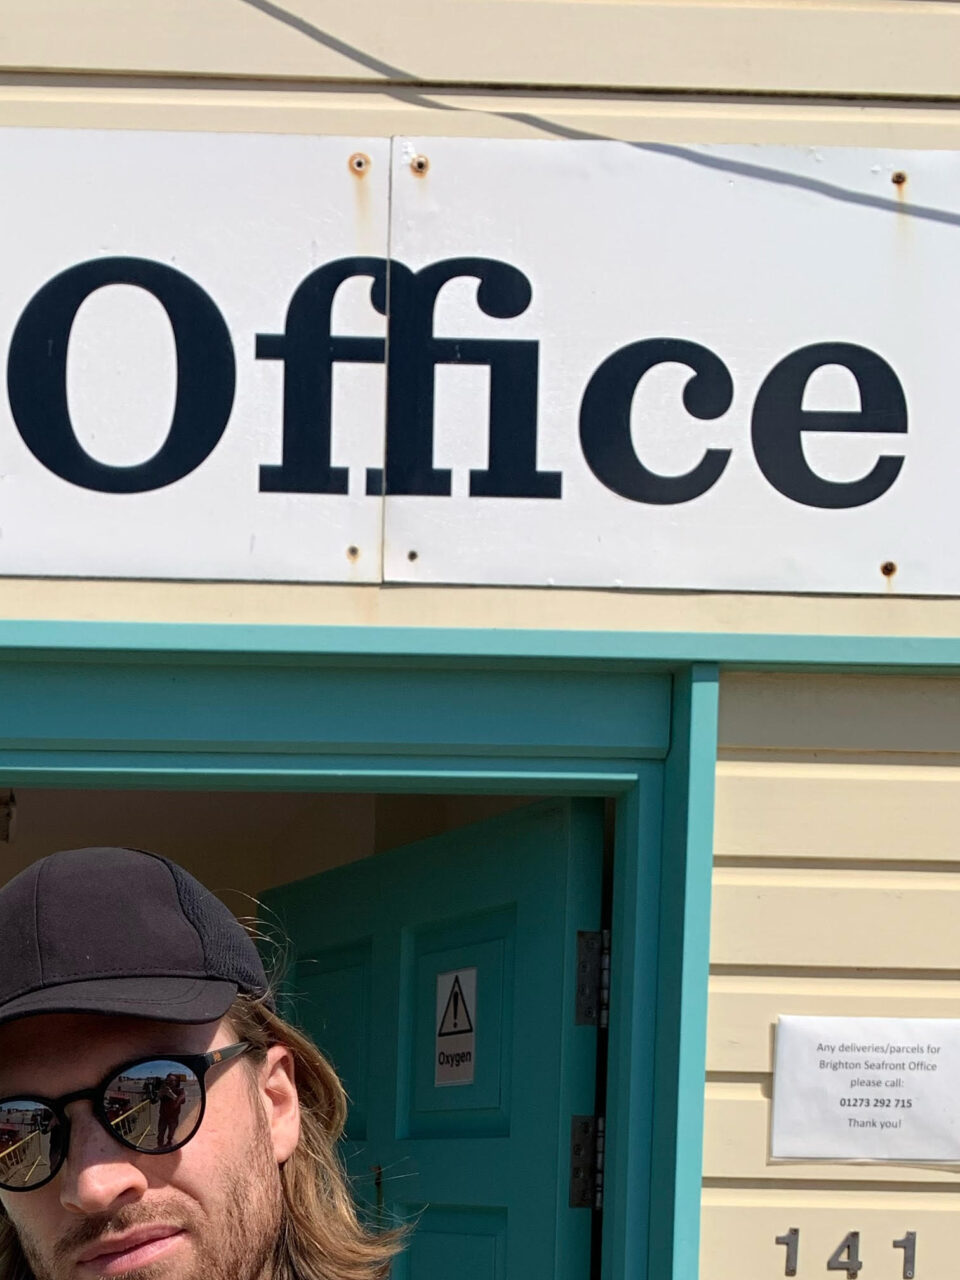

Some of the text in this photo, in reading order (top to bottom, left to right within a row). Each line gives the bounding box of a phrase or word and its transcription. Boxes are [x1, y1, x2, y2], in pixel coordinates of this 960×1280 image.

[7, 256, 908, 509] Office
[816, 1042, 941, 1055] Any deliveries/parcels for
[438, 1051, 472, 1067] Oxygen
[819, 1060, 938, 1072] Brighton Seafront Office
[850, 1078, 905, 1088] please call:
[839, 1098, 913, 1108] 01273 292 715
[848, 1118, 902, 1129] Thank you!
